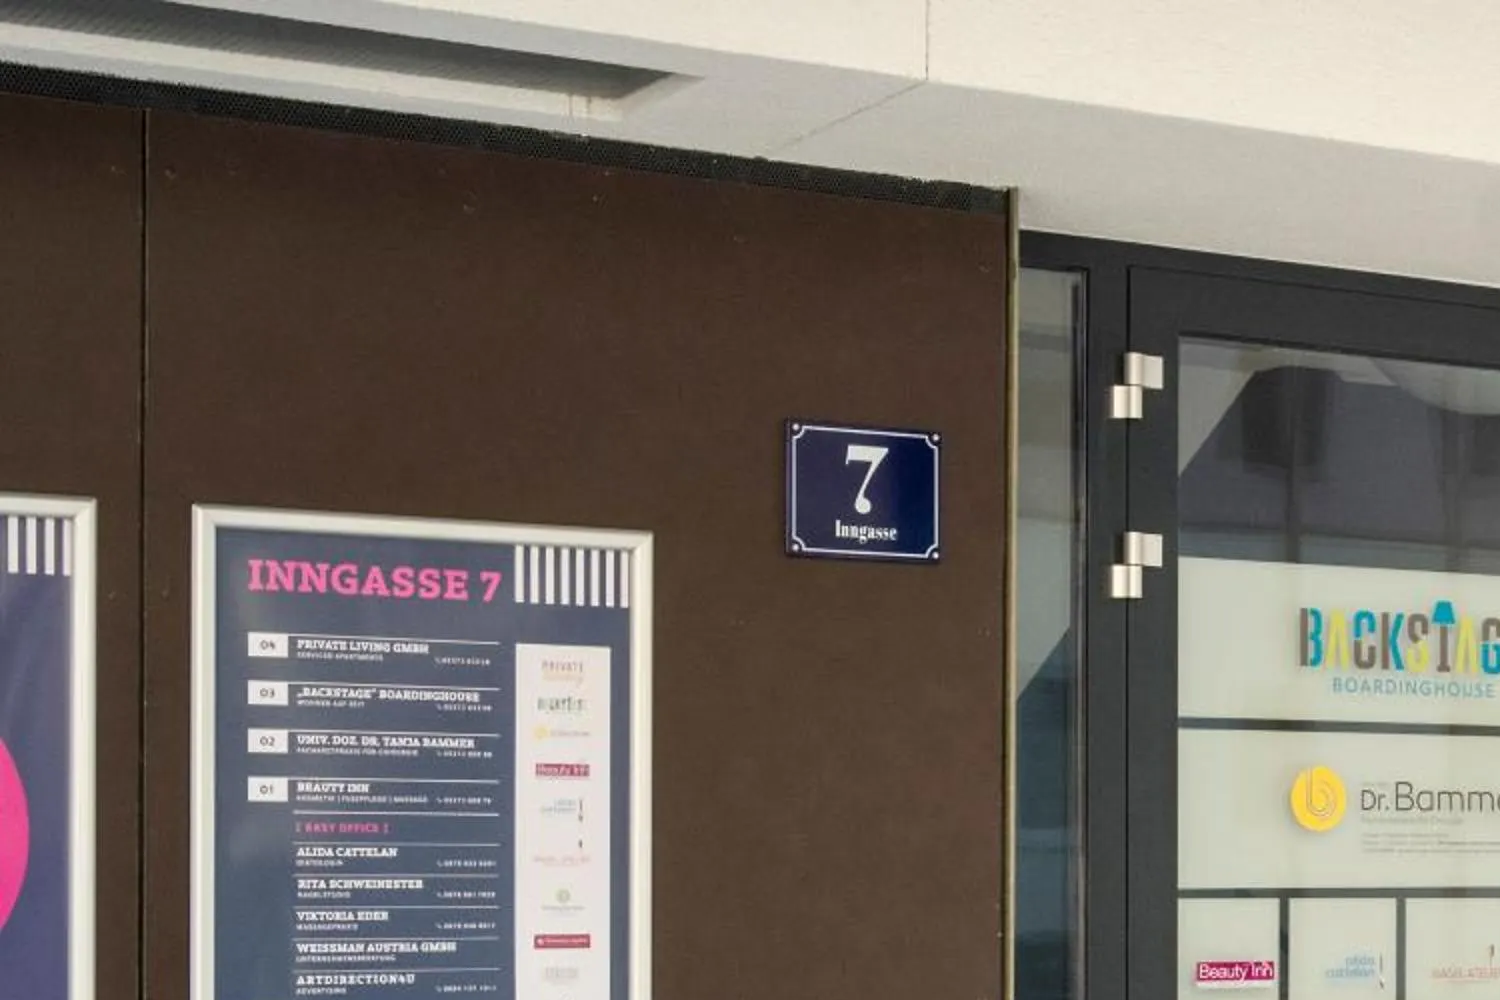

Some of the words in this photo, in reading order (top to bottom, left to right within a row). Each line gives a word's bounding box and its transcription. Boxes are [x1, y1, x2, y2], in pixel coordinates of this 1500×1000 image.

[845, 444, 889, 515] 7
[835, 519, 898, 545] Inngasse
[247, 558, 470, 601] INNGASSE
[480, 571, 503, 602] 7
[260, 639, 276, 651] 04
[297, 639, 349, 652] PRIVATE
[350, 641, 392, 653] LIVING
[394, 643, 430, 655] GMBH
[260, 687, 275, 698] 03
[1332, 677, 1496, 699] BOARDINGHOUSE
[379, 690, 480, 703] BOARDINGHOUSE
[260, 736, 275, 747] 02
[422, 739, 475, 750] BAMMER
[260, 784, 274, 795] 01
[296, 783, 345, 794] BEAUTY
[1361, 788, 1390, 812] Dr.
[339, 822, 380, 834] OFFICE
[296, 847, 334, 858] ALIDA
[336, 847, 399, 858] CATTELAN
[297, 879, 327, 890] RITA
[296, 911, 354, 922] VIKTORIA
[357, 911, 389, 922] EDER
[368, 942, 419, 953] AUSTRIA
[1200, 963, 1249, 984] Beauty
[1251, 961, 1274, 977] Inn
